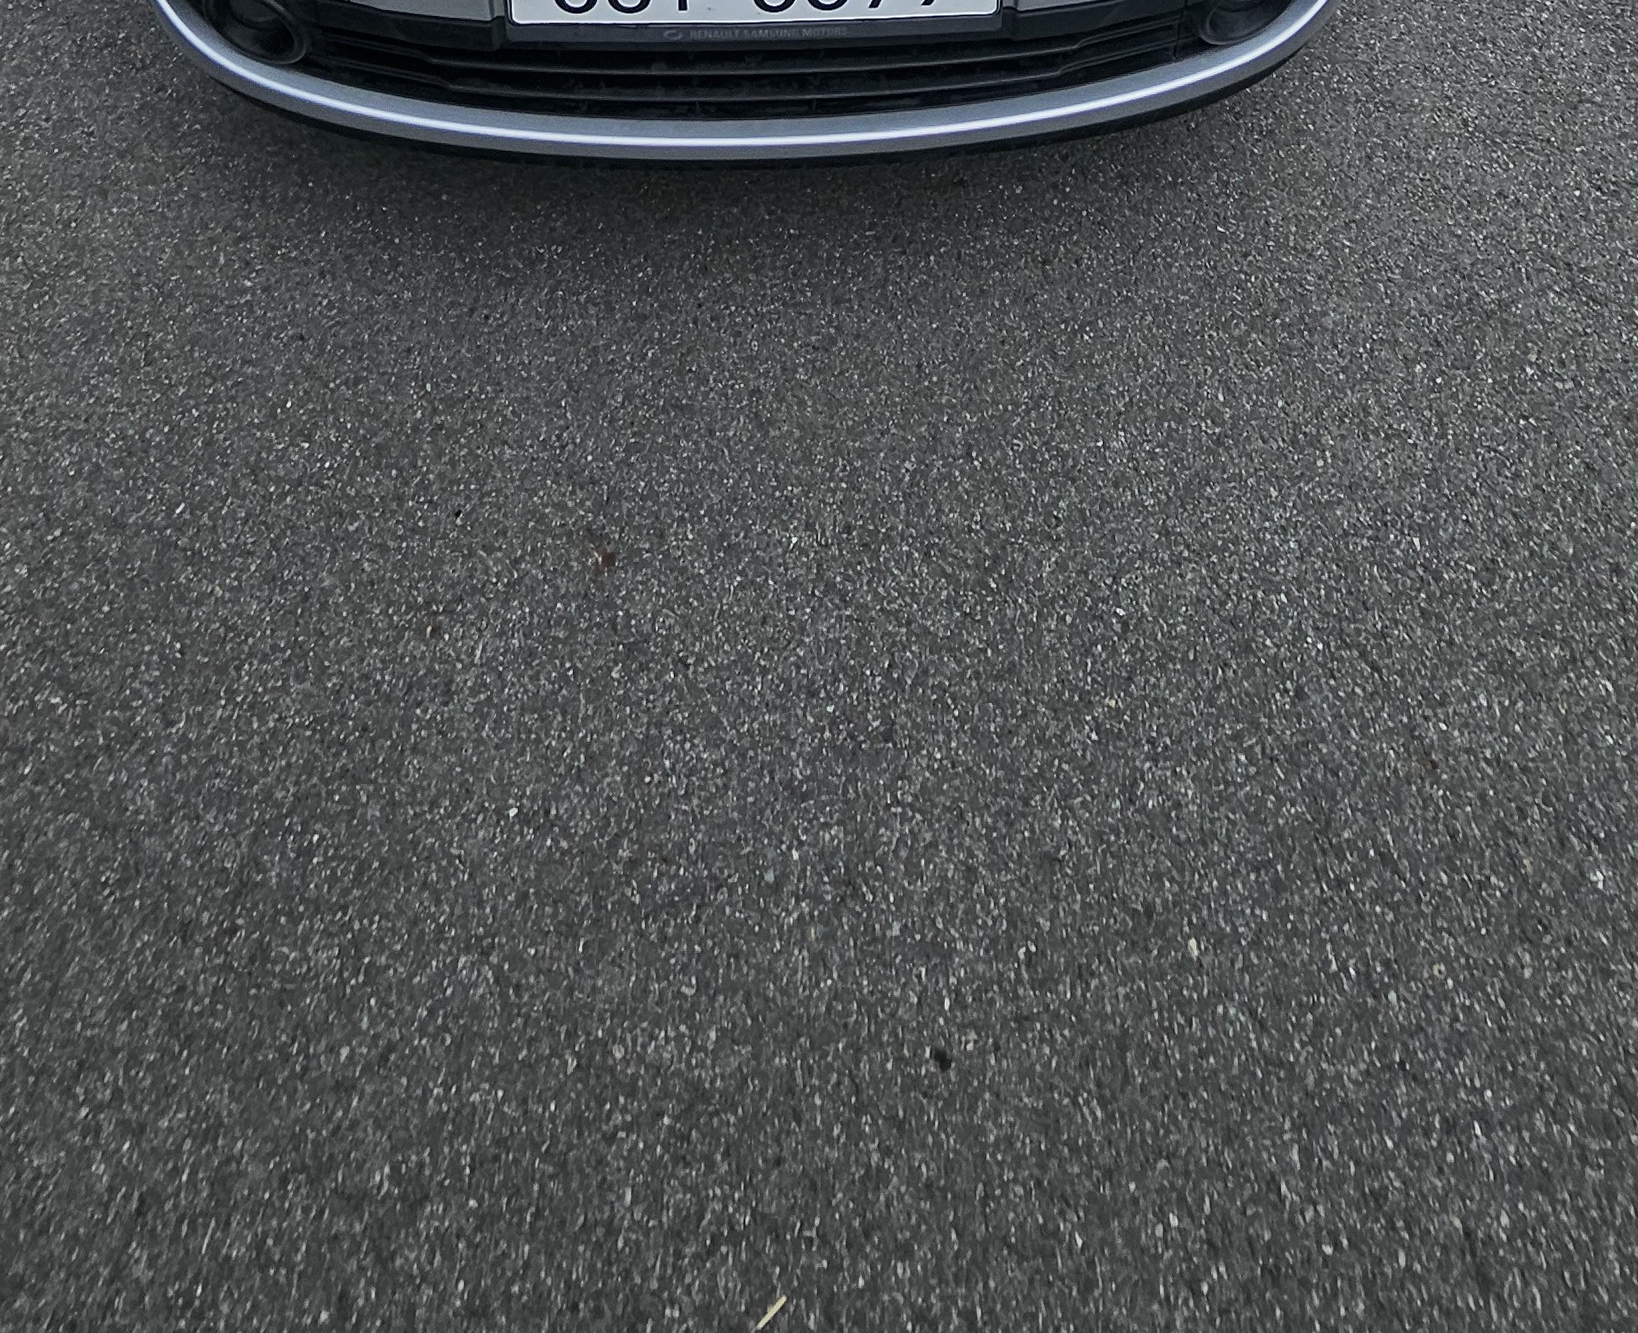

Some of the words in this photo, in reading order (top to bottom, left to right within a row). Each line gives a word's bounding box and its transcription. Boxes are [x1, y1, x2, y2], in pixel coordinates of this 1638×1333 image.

[689, 28, 741, 39] RENAULT
[743, 27, 800, 38] SAMSUNG
[802, 26, 848, 37] MOTORS
